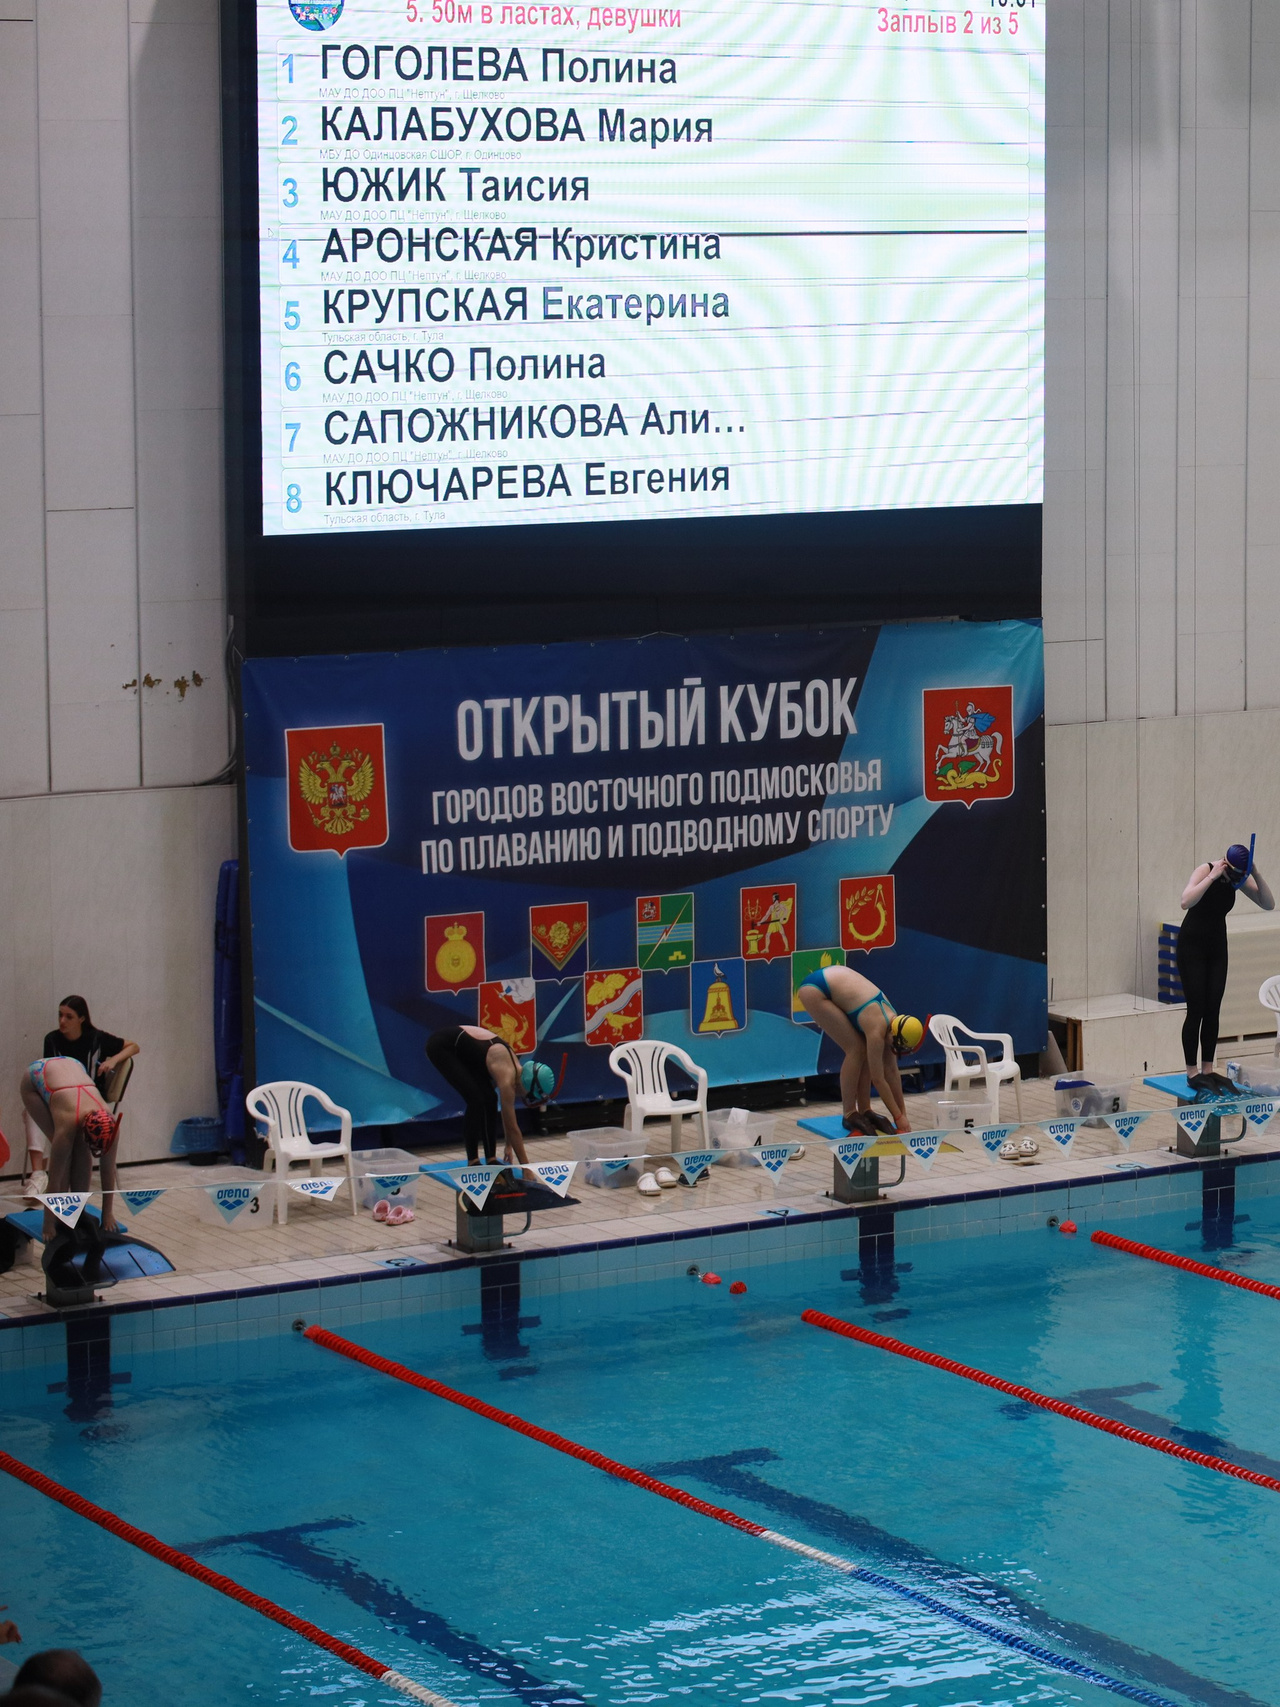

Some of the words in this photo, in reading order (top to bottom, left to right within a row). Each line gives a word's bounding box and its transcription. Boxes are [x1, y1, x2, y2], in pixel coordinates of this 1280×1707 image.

[406, 0, 424, 23] 5.
[432, 0, 473, 24] 50м
[481, 8, 492, 26] в
[499, 8, 580, 29] ластах,
[587, 8, 682, 33] девушки
[877, 7, 957, 34] Заплыв
[963, 10, 974, 34] 2
[981, 16, 1002, 35] из
[1008, 11, 1018, 35] 5
[281, 54, 294, 84] 1
[321, 44, 528, 82] ГОГОЛЕВА
[542, 48, 677, 85] Полина
[318, 88, 341, 99] МАУ
[343, 88, 359, 100] ДО
[362, 88, 386, 100] ДОО
[389, 88, 404, 100] ПЦ
[463, 89, 505, 100] Щелково
[281, 115, 298, 145] 2
[321, 105, 585, 142] КАЛАБУХОВА
[599, 108, 713, 149] Мария
[319, 149, 342, 160] МБУ
[344, 149, 360, 161] ДО
[363, 150, 427, 160] Одинцовская
[474, 150, 521, 161] Одинцово
[282, 177, 299, 207] 3
[322, 167, 446, 203] ЮЖИК
[459, 167, 589, 202] Таисия
[320, 210, 342, 221] МАУ
[345, 210, 360, 222] ДО
[363, 210, 386, 222] ДОО
[390, 210, 405, 221] ПЦ
[463, 210, 506, 221] Щелково
[282, 240, 300, 269] 4
[321, 226, 537, 263] АРОНСКАЯ
[552, 228, 721, 267] Кристина
[320, 271, 343, 282] МАУ
[345, 271, 361, 283] ДО
[363, 271, 387, 283] ДОО
[390, 271, 405, 282] ПЦ
[464, 270, 506, 281] Щелково
[283, 301, 301, 330] 5
[323, 286, 528, 324] КРУПСКАЯ
[543, 286, 730, 325] Екатерина
[322, 332, 366, 345] Тульская
[368, 331, 410, 343] область,
[421, 331, 444, 343] Тула
[284, 361, 301, 392] 6
[324, 347, 454, 384] САЧКО
[470, 346, 606, 383] Полина
[322, 392, 345, 403] МАУ
[347, 392, 362, 404] ДО
[365, 392, 389, 404] ДОО
[391, 391, 407, 403] ПЦ
[465, 389, 508, 400] Щелково
[285, 422, 301, 453] 7
[325, 403, 629, 445] САПОЖНИКОВА
[323, 453, 346, 464] МАУ
[347, 453, 363, 465] ДО
[366, 452, 389, 464] ДОО
[392, 452, 408, 463] ПЦ
[465, 449, 508, 460] Щелково
[286, 483, 303, 514] 8
[326, 463, 572, 506] КЛЮЧАРЕВА
[585, 462, 730, 497] Евгения
[324, 514, 368, 527] Тульская
[370, 513, 412, 524] область,
[423, 511, 446, 523] Тула
[457, 678, 706, 761] ОТКРЫТЫЙ
[720, 677, 858, 744] КУБОК
[432, 784, 543, 825] ГОРОДОВ
[551, 772, 702, 816] ВОСТОЧНОГО
[711, 759, 882, 805] ПОДМОСКОВЬЯ
[421, 839, 454, 875] ПО
[460, 826, 601, 872] ПЛАВАНИЮ
[608, 825, 624, 858] И
[632, 812, 802, 858] ПОДВОДНОМУ
[808, 803, 894, 842] СПОРТУ
[1112, 1097, 1120, 1113] 5
[1246, 1103, 1274, 1114] arena
[1115, 1116, 1140, 1128] arena
[1180, 1110, 1206, 1121] arena
[964, 1118, 974, 1134] 5
[1049, 1123, 1075, 1135] arena
[910, 1136, 938, 1148] arena
[982, 1130, 1008, 1141] arena
[760, 1149, 789, 1161] arena
[838, 1142, 865, 1154] arena
[684, 1154, 713, 1166] arena
[538, 1164, 570, 1176] arena
[460, 1172, 491, 1184] arena
[47, 1195, 81, 1206] arena
[217, 1188, 250, 1199] arena
[250, 1197, 260, 1214] 3
